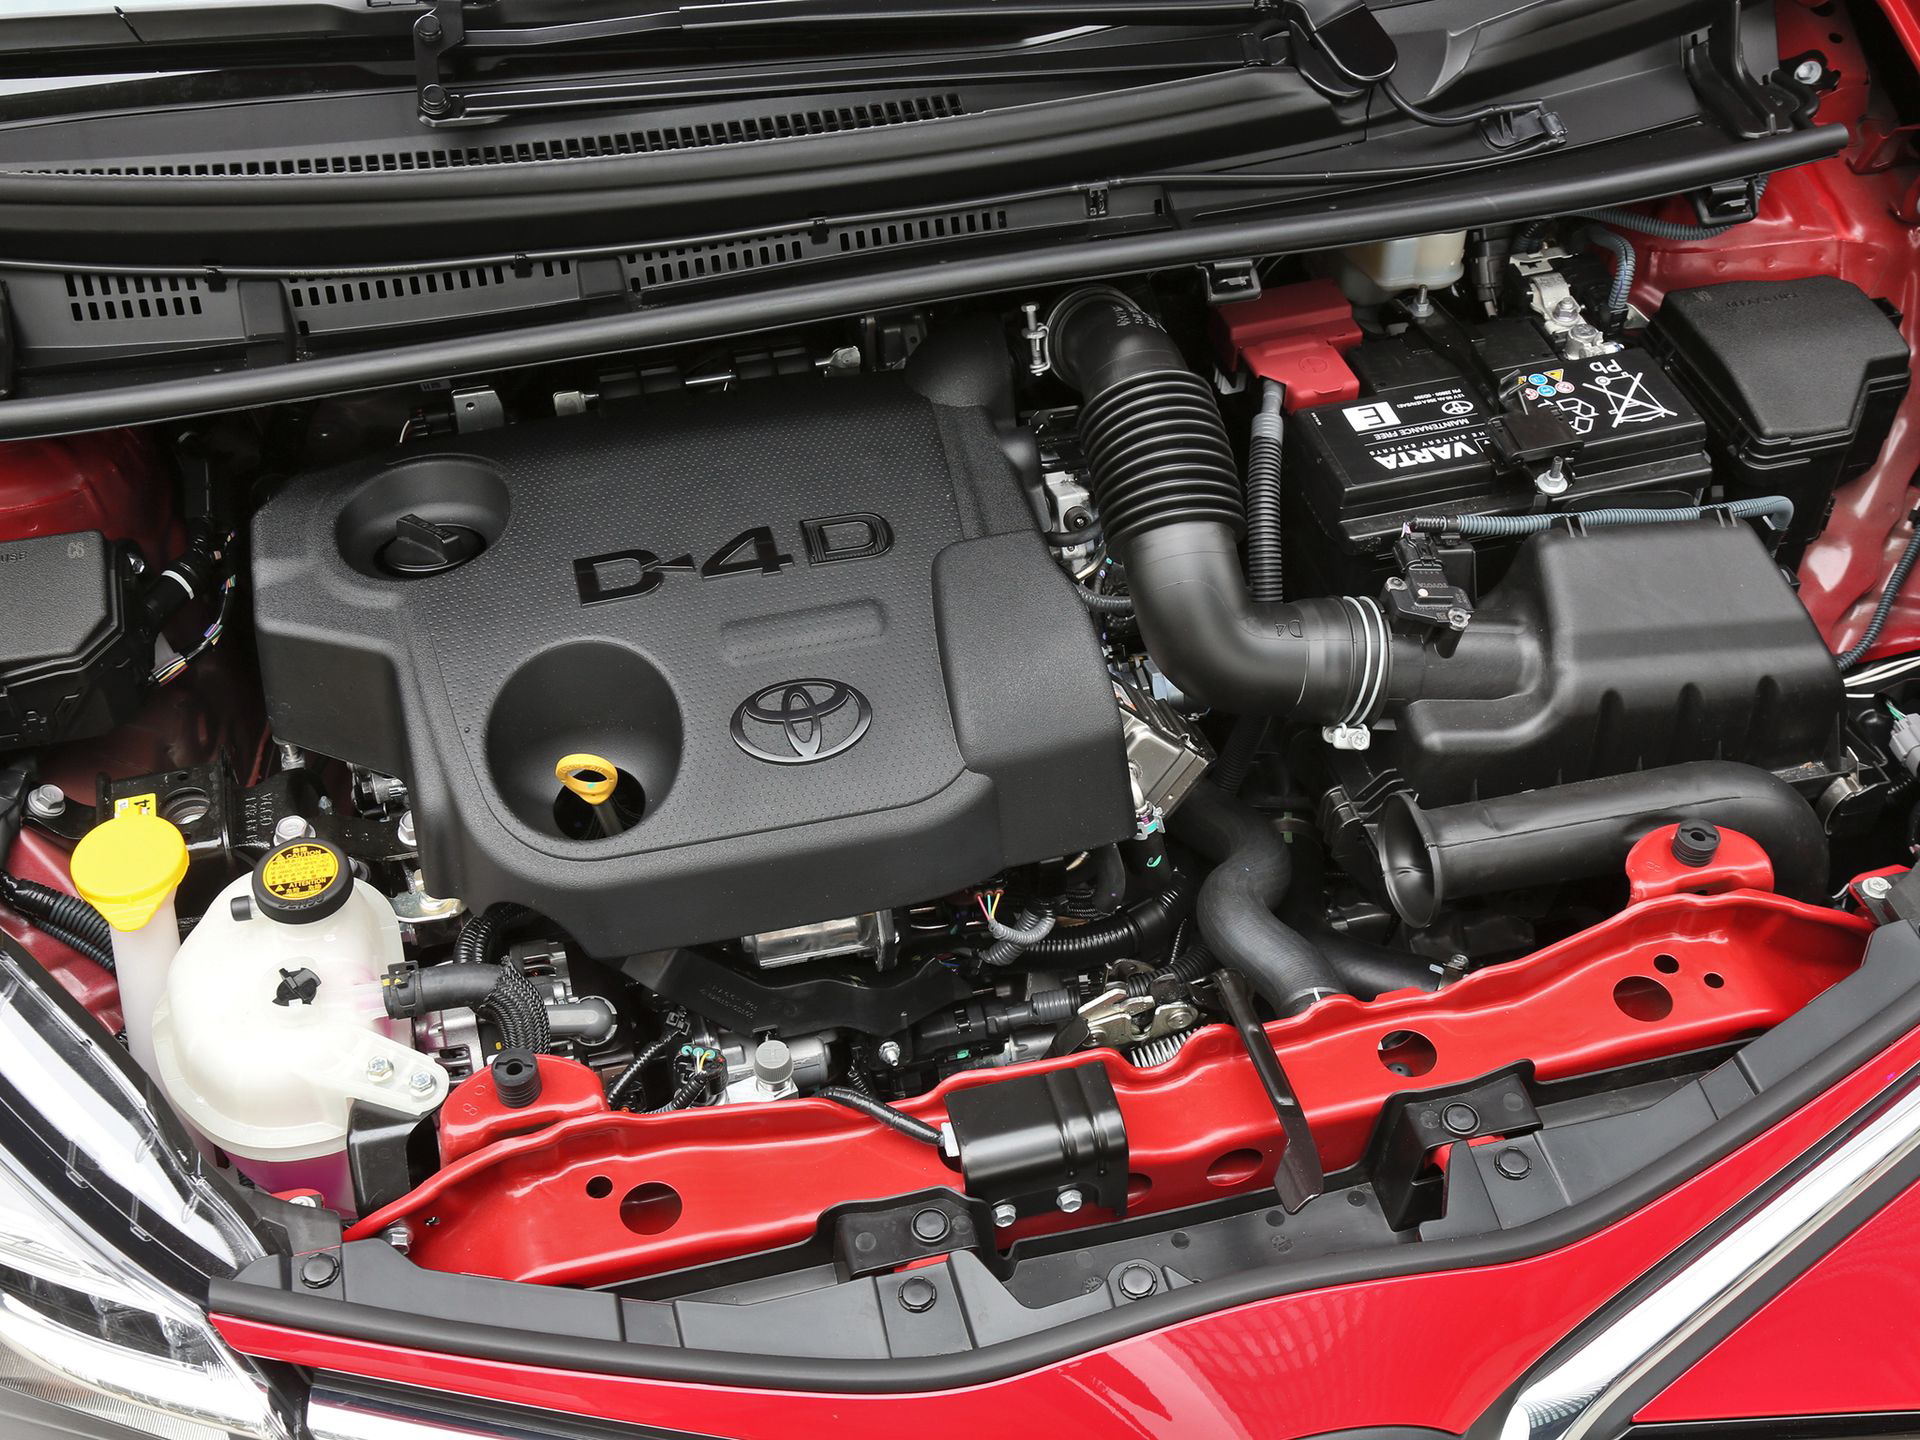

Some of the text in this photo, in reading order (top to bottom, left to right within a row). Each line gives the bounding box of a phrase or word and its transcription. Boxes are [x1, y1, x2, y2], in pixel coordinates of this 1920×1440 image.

[1589, 359, 1623, 374] Pb
[1358, 406, 1386, 427] E
[1373, 417, 1470, 440] MAINTENANCE FREE
[1421, 434, 1467, 447] BATTERY
[1368, 443, 1417, 457] EXPERTS
[1373, 441, 1478, 470] VARTA
[573, 512, 895, 609] D-4D
[1274, 619, 1304, 638] D4
[286, 849, 321, 859] CAUTION
[288, 877, 327, 888] ATTENTION
